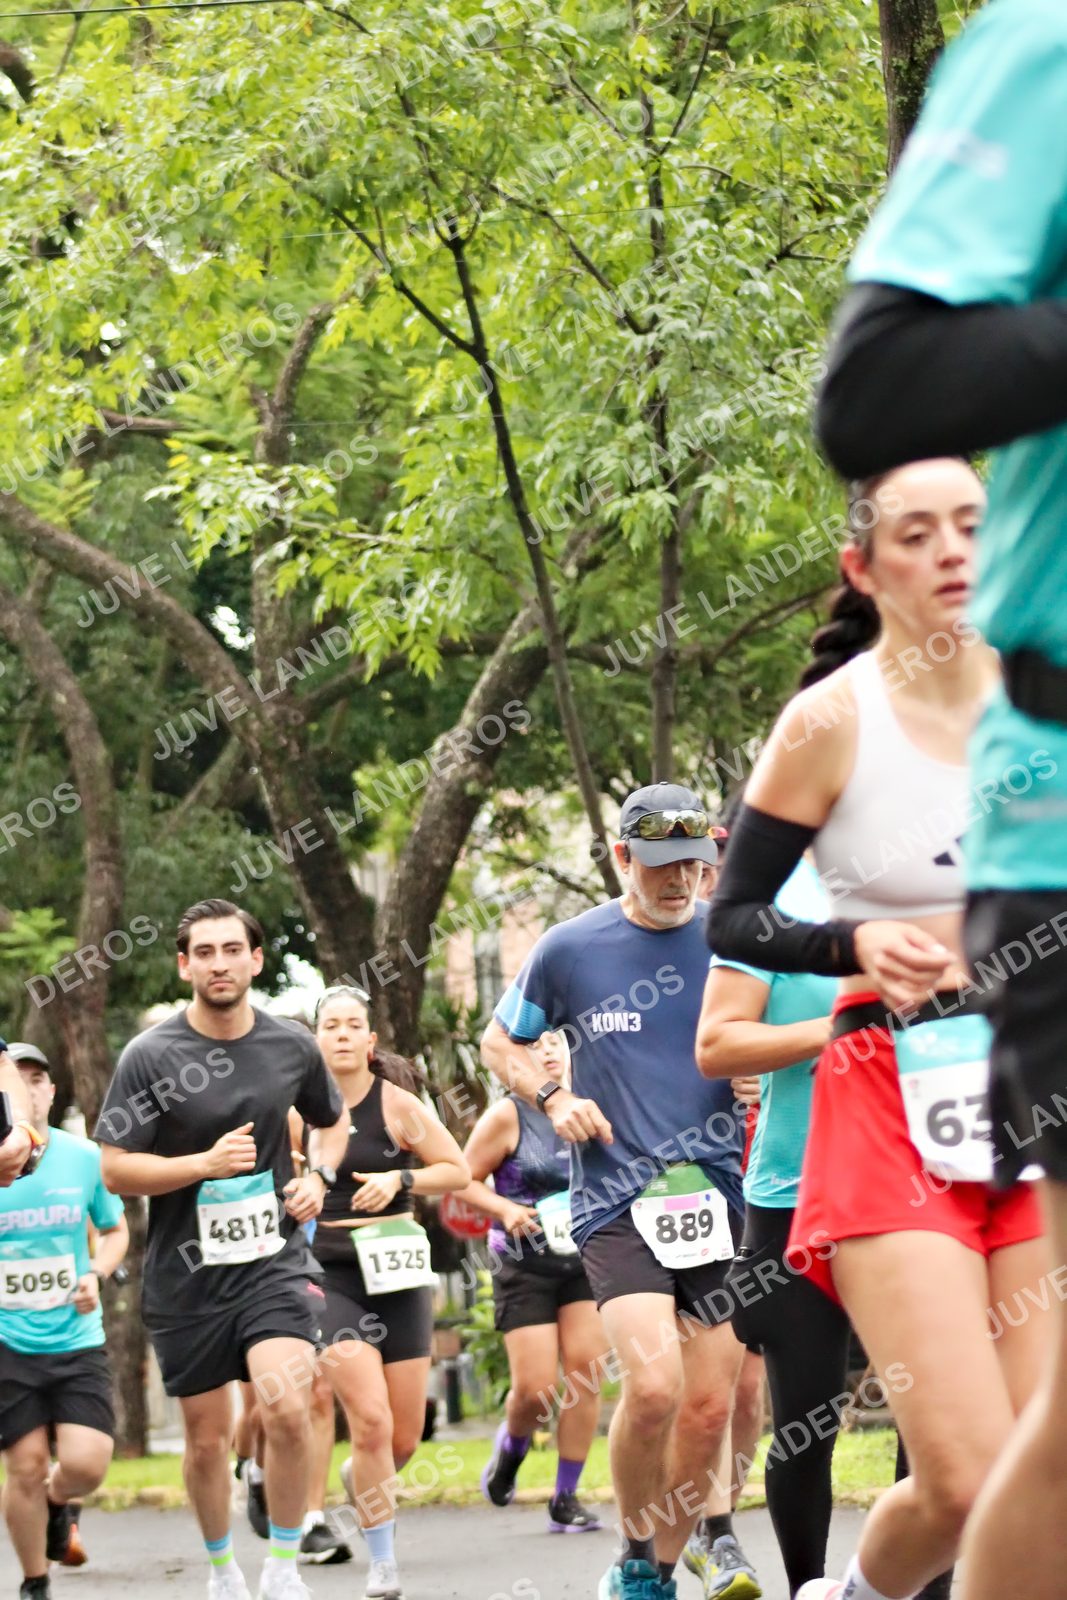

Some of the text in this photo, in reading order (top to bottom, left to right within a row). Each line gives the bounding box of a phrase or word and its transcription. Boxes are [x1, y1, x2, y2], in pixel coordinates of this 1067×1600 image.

[592, 1012, 641, 1032] KON3
[209, 1210, 275, 1243] 4812
[656, 1209, 713, 1244] 889
[369, 1249, 425, 1273] 1325
[6, 1270, 70, 1294] 5096
